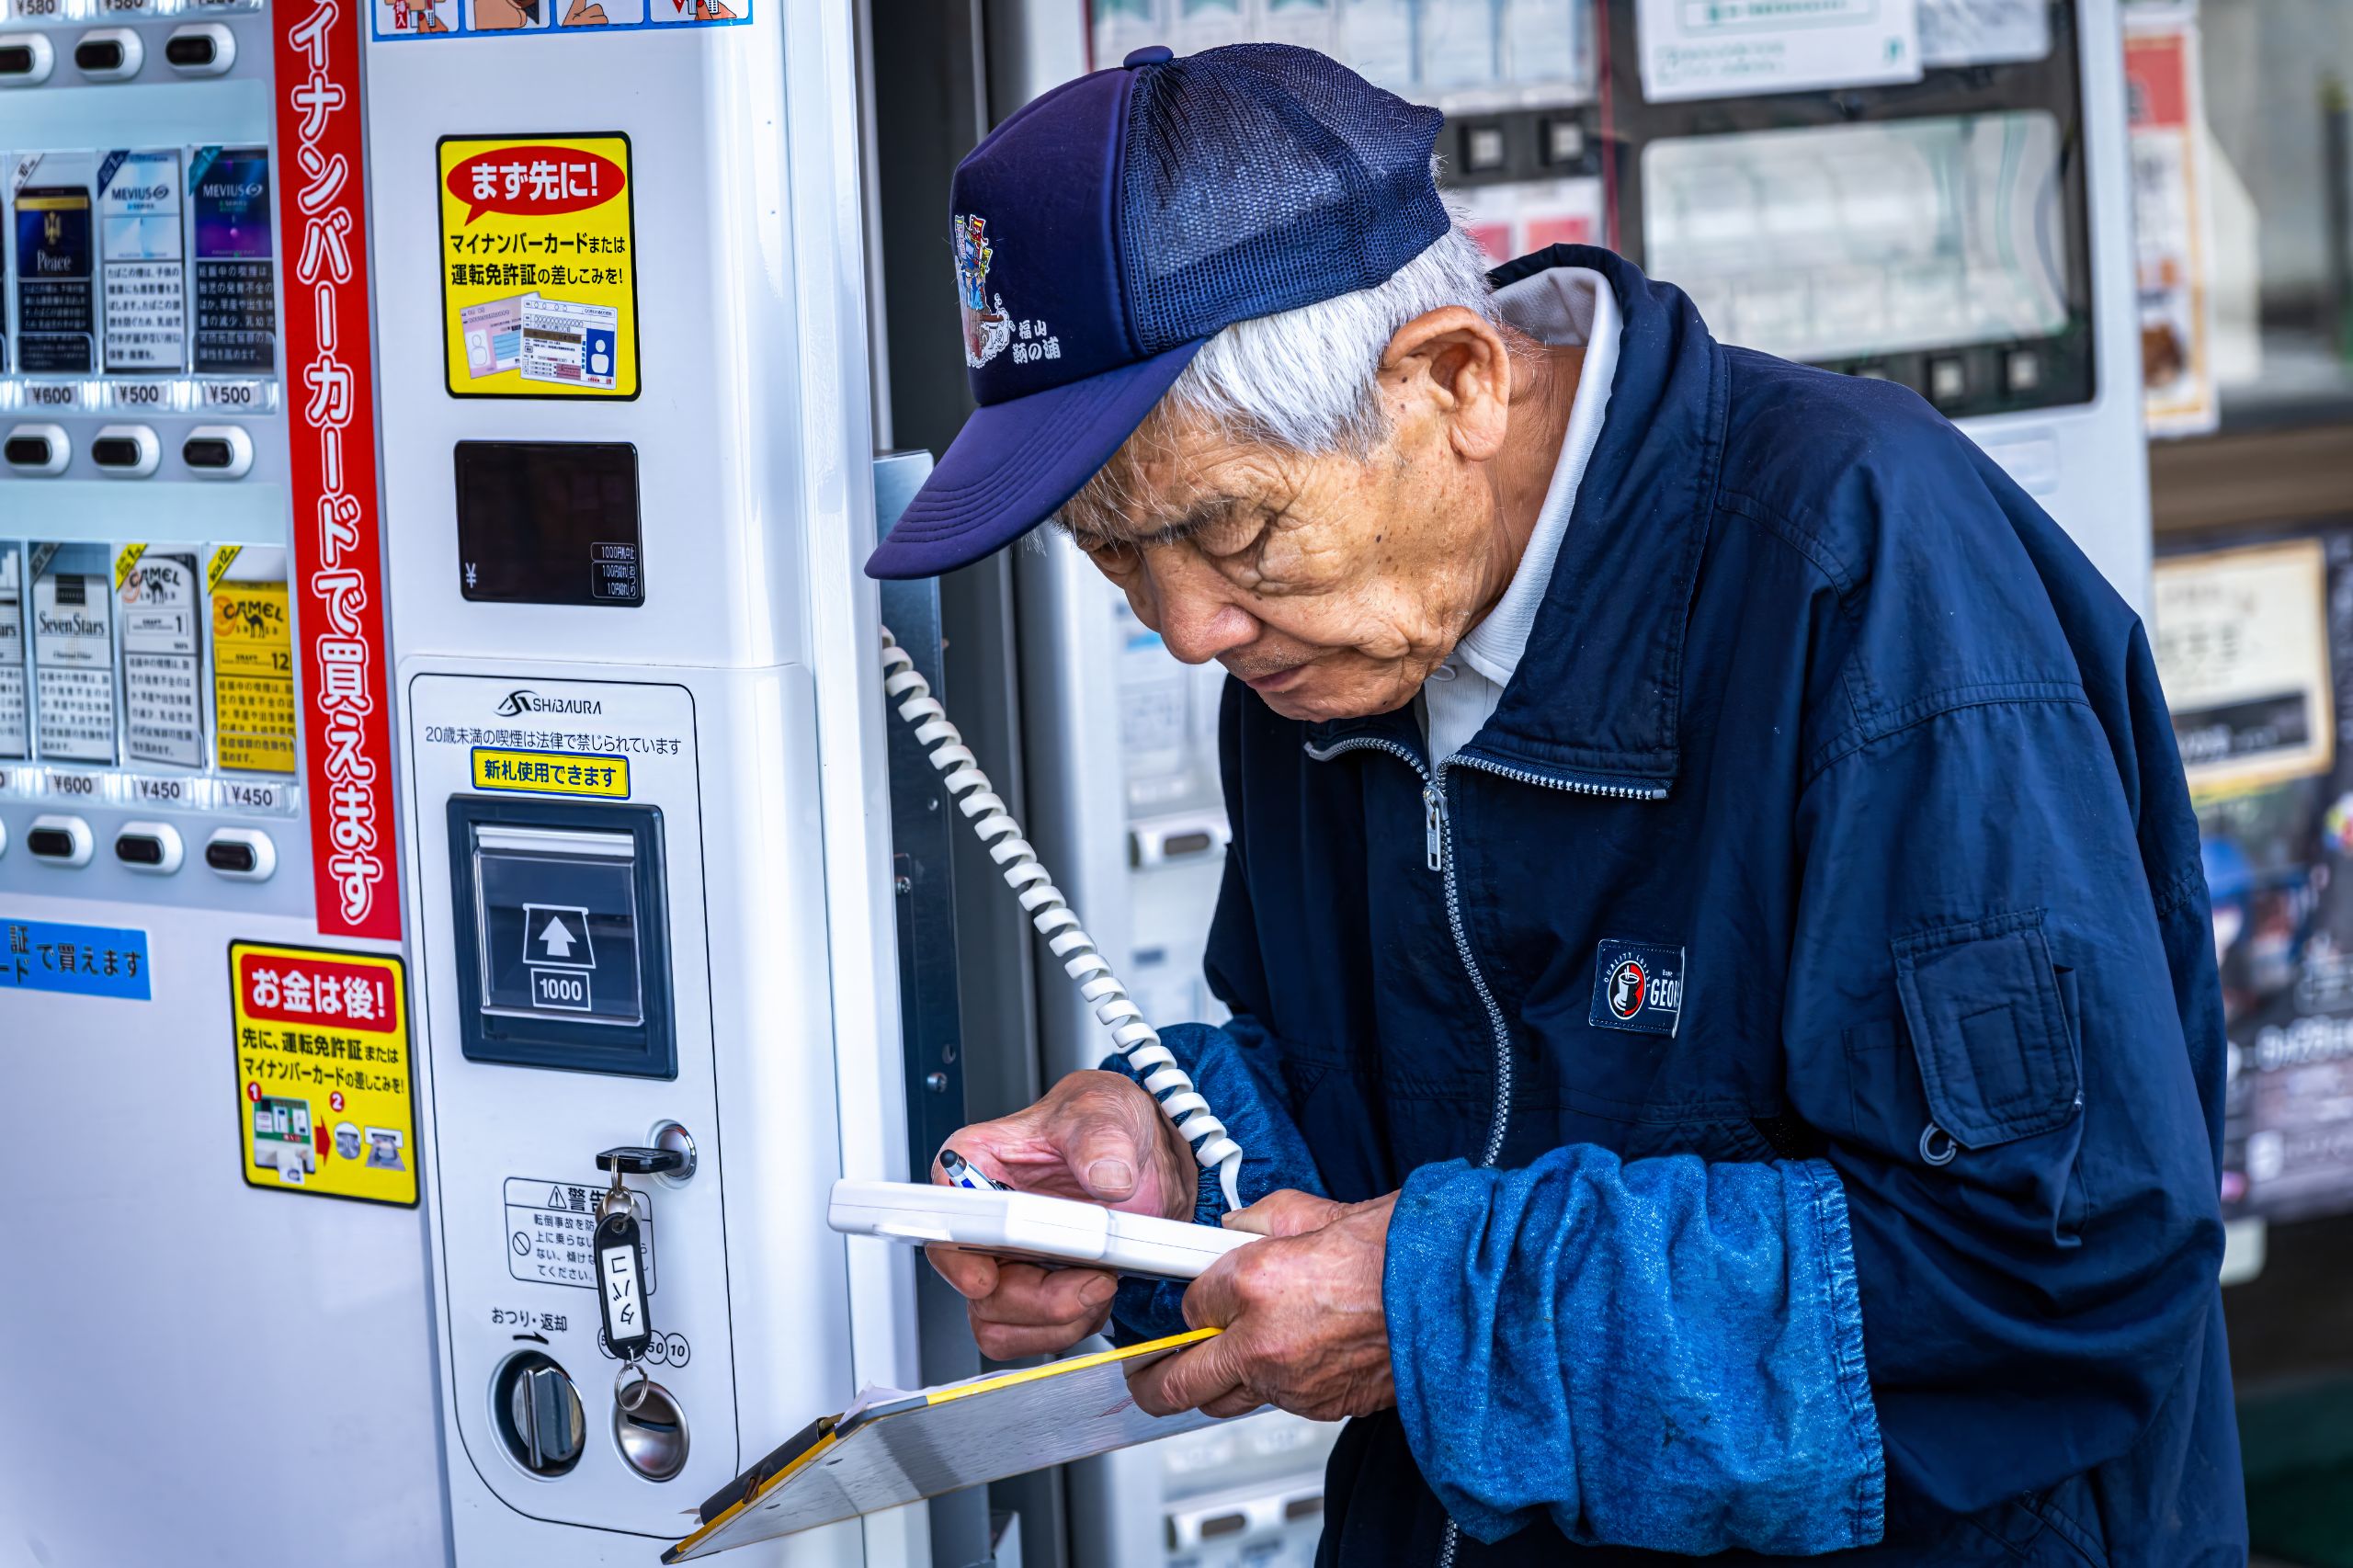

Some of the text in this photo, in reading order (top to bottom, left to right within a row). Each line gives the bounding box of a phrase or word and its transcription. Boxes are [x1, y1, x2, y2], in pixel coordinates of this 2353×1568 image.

[202, 183, 245, 199] MEVIUS
[471, 160, 599, 201] まず先に!
[111, 186, 153, 201] MEVIUS
[450, 232, 626, 256] マイナンバーカードまたは
[37, 249, 73, 272] Peace
[450, 263, 624, 287] 運転免許証の差しこみを!
[1018, 319, 1048, 340] 福山
[33, 386, 72, 404] ¥600
[119, 384, 159, 403] ¥500
[210, 385, 251, 404] ¥500
[289, 0, 382, 925] イナンバーカードで買えます
[129, 566, 181, 588] CAMEL
[223, 600, 284, 622] CAMEL
[271, 652, 290, 671] 12
[425, 724, 683, 756] 20歳未満の喫煙は法律で禁じられています
[483, 759, 618, 788] 新札使用できます
[54, 775, 93, 795] ¥600
[141, 779, 180, 800] ¥450
[232, 785, 273, 807] ¥450
[36, 942, 142, 978] で買えます
[251, 968, 386, 1020] お金は後!
[540, 978, 582, 1002] 1000
[243, 1057, 404, 1094] マイナンバーカードの差しこみを!
[491, 1306, 568, 1333] おつり・返却
[670, 1345, 685, 1358] 10
